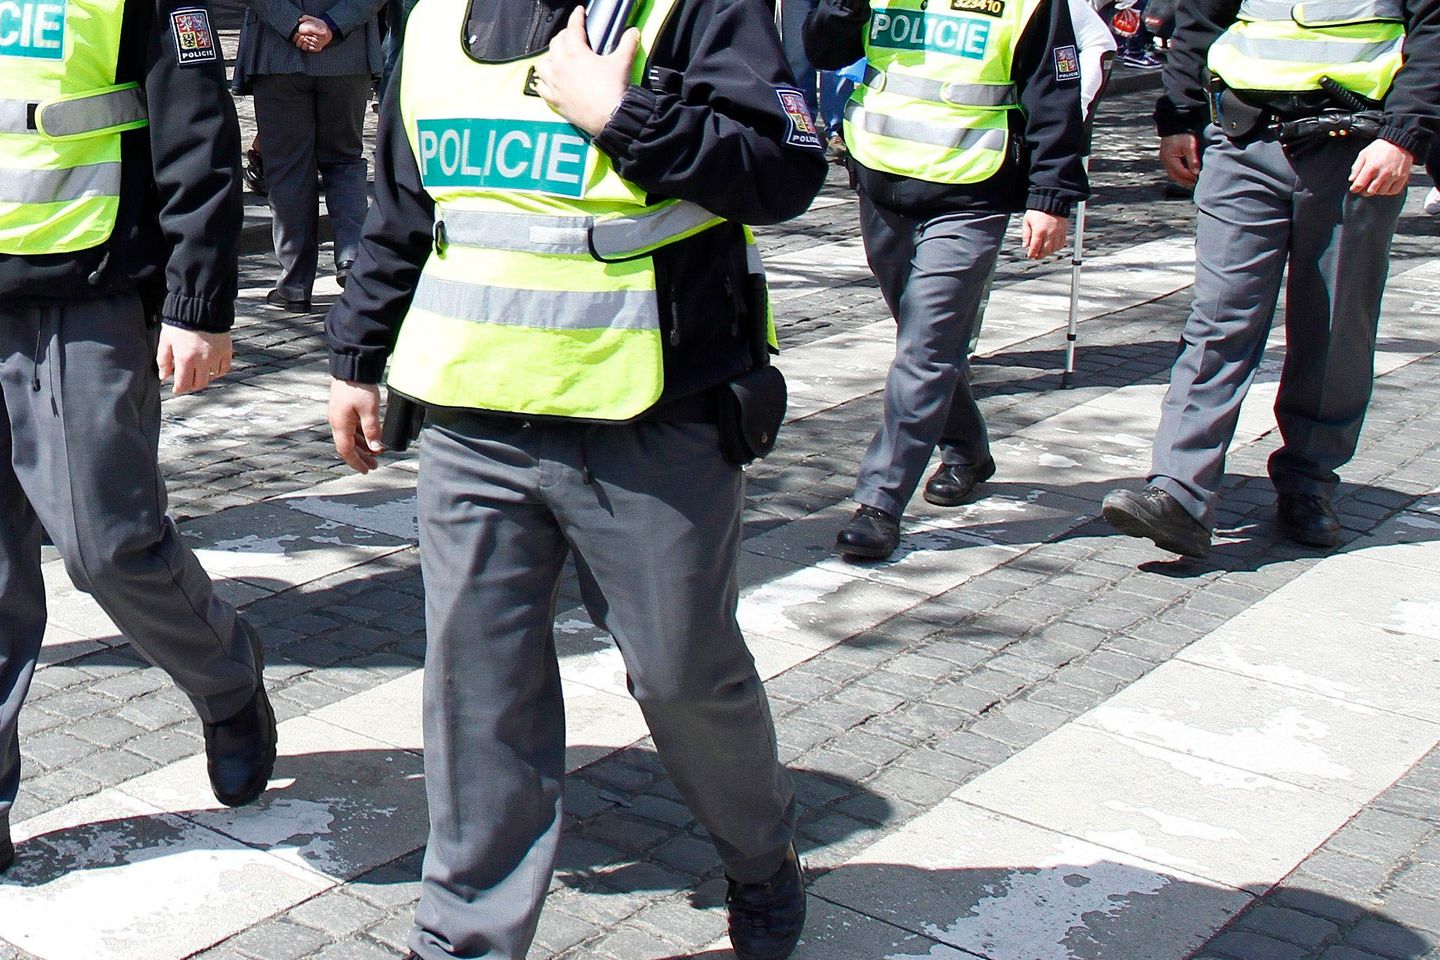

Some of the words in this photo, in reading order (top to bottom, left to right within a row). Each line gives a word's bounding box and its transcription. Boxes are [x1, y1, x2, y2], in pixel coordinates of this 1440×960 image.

[871, 13, 987, 54] POLICIE
[182, 50, 213, 59] POLICIE
[421, 127, 584, 185] POLICIE
